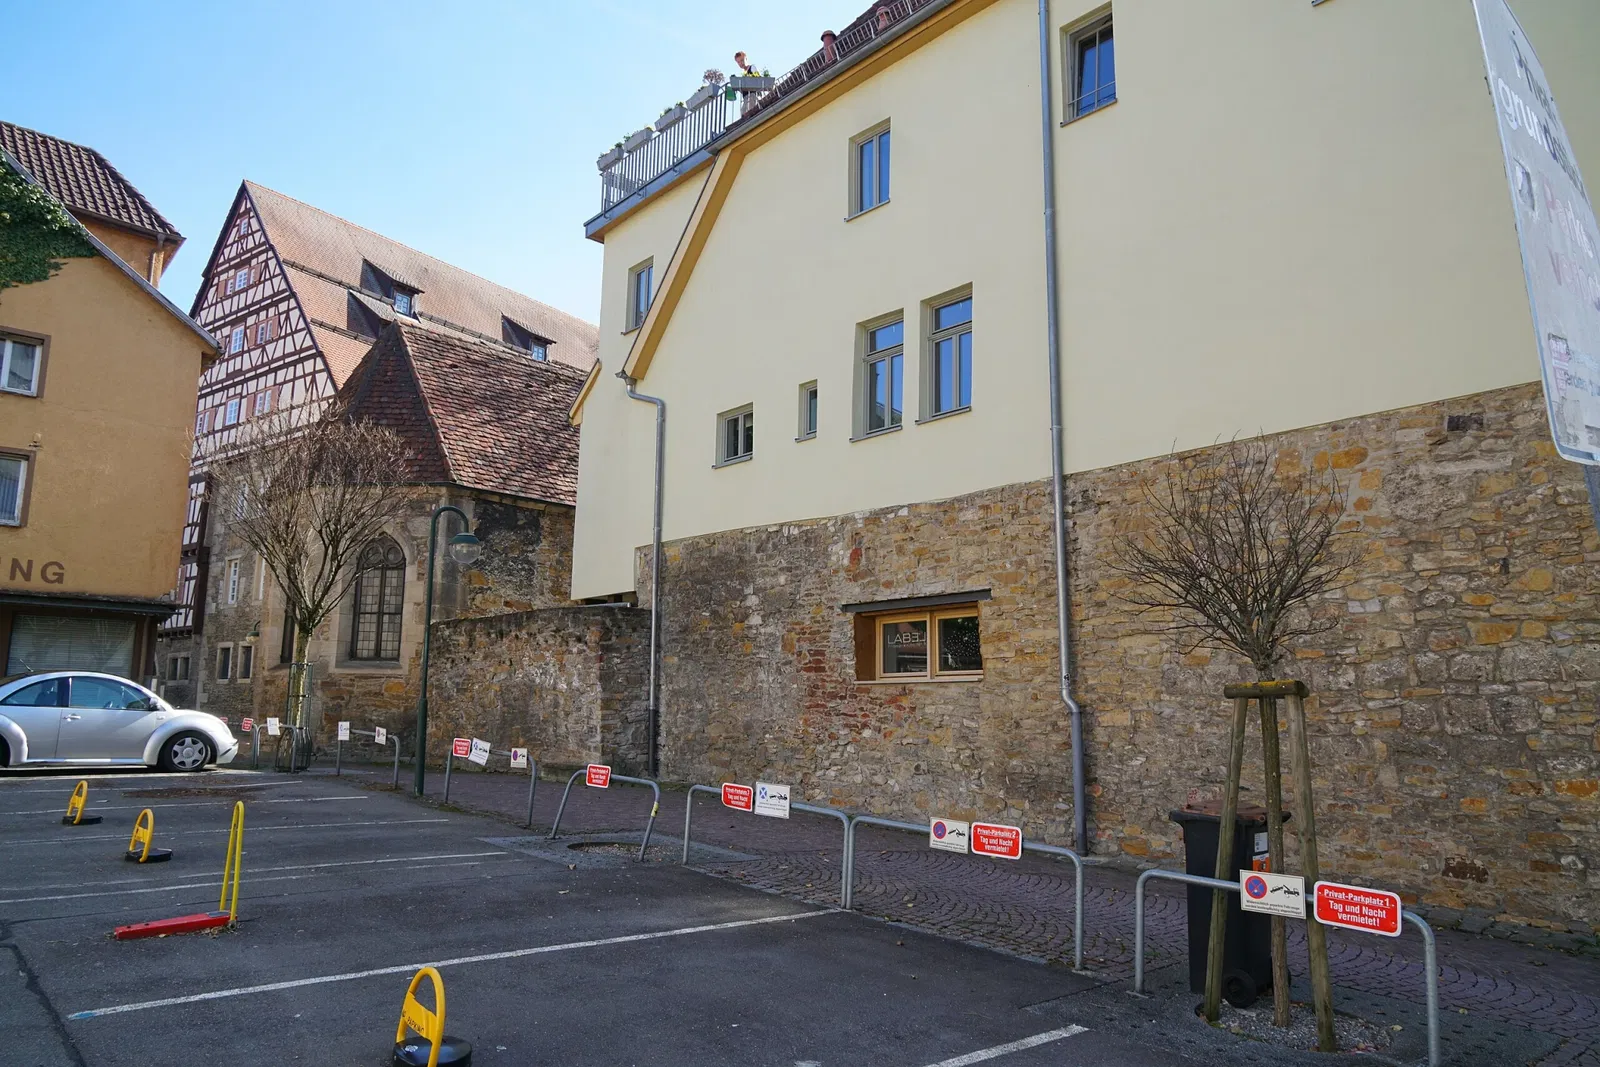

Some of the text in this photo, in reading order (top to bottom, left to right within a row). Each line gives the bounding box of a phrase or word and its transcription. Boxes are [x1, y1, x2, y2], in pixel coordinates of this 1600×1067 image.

[0, 557, 65, 584] NG
[980, 836, 988, 845] Tag
[999, 839, 1013, 847] Nacht
[1324, 889, 1390, 907] Privat-Parkplatz 1
[1329, 900, 1386, 919] Tag und Nacht
[1338, 913, 1380, 927] vermietet!
